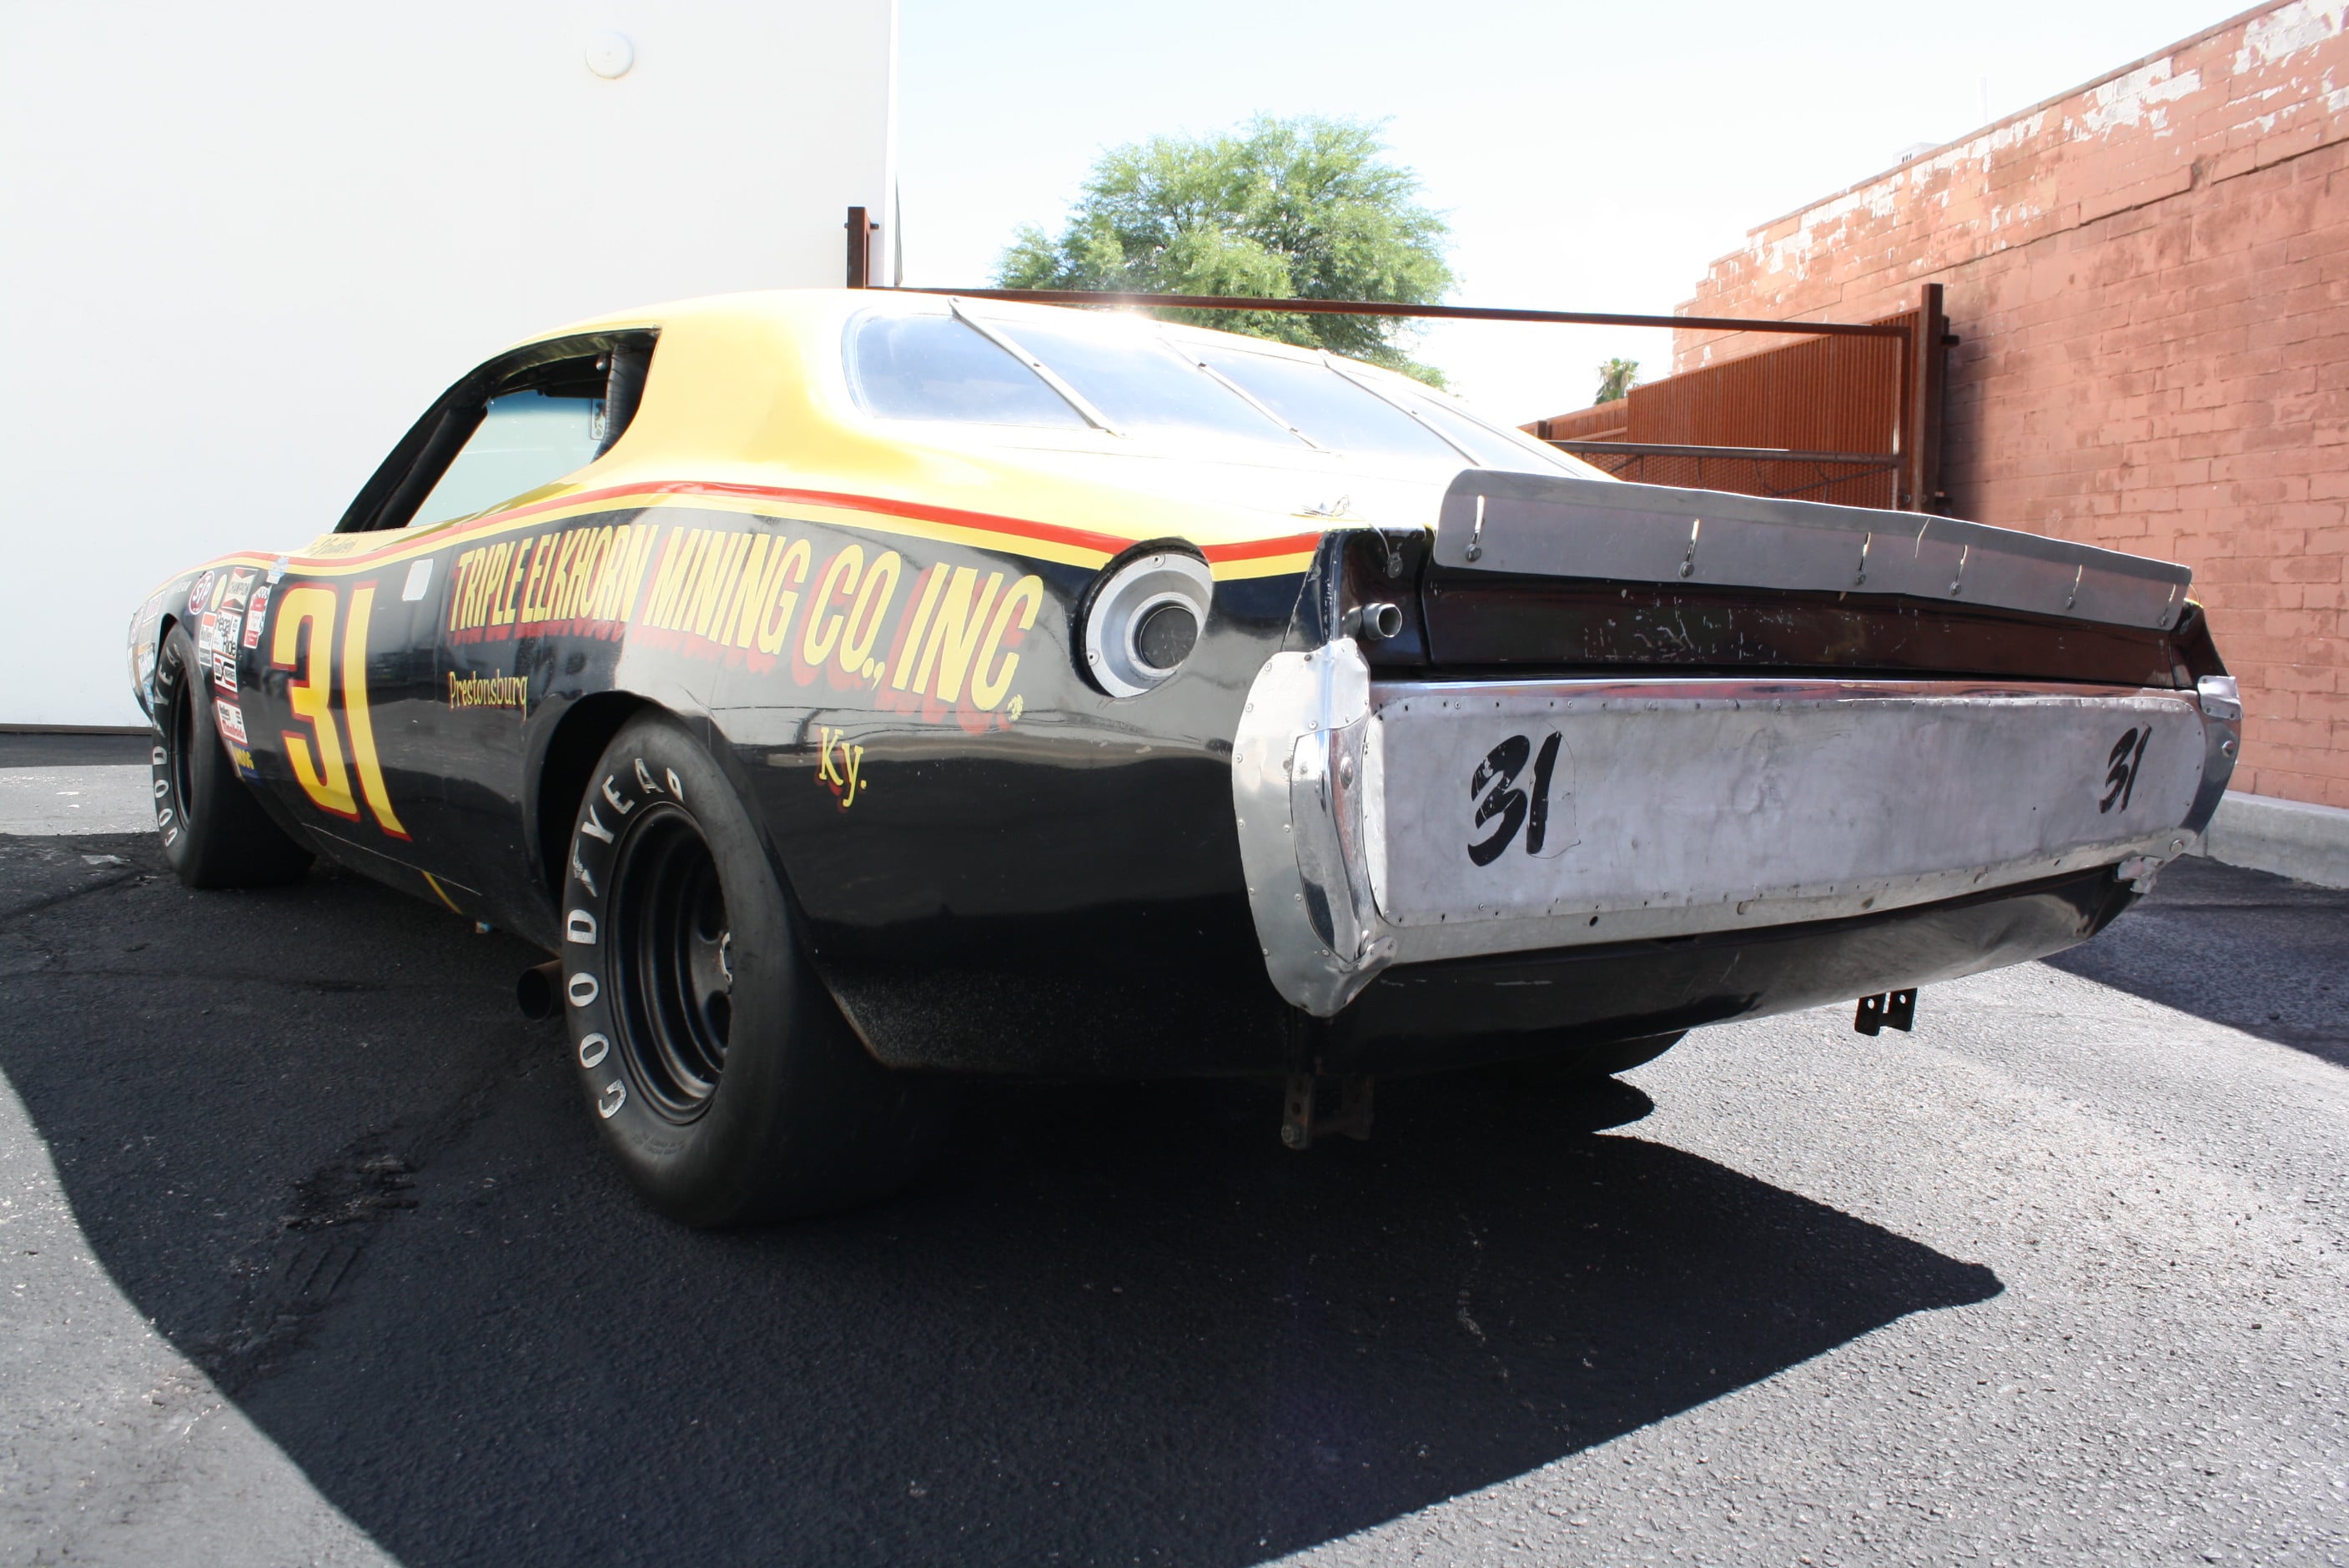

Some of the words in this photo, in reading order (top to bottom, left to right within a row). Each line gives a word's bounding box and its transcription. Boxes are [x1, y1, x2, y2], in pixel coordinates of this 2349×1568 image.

[192, 574, 212, 605] STP
[449, 537, 533, 632] TRIPLE
[521, 524, 661, 624] ELKHORN
[642, 525, 811, 656] MINING
[271, 580, 414, 842] 31
[447, 668, 530, 724] Prestonsburg
[818, 726, 868, 808] Ky.
[1468, 731, 1563, 867] 31
[2099, 721, 2152, 815] 31
